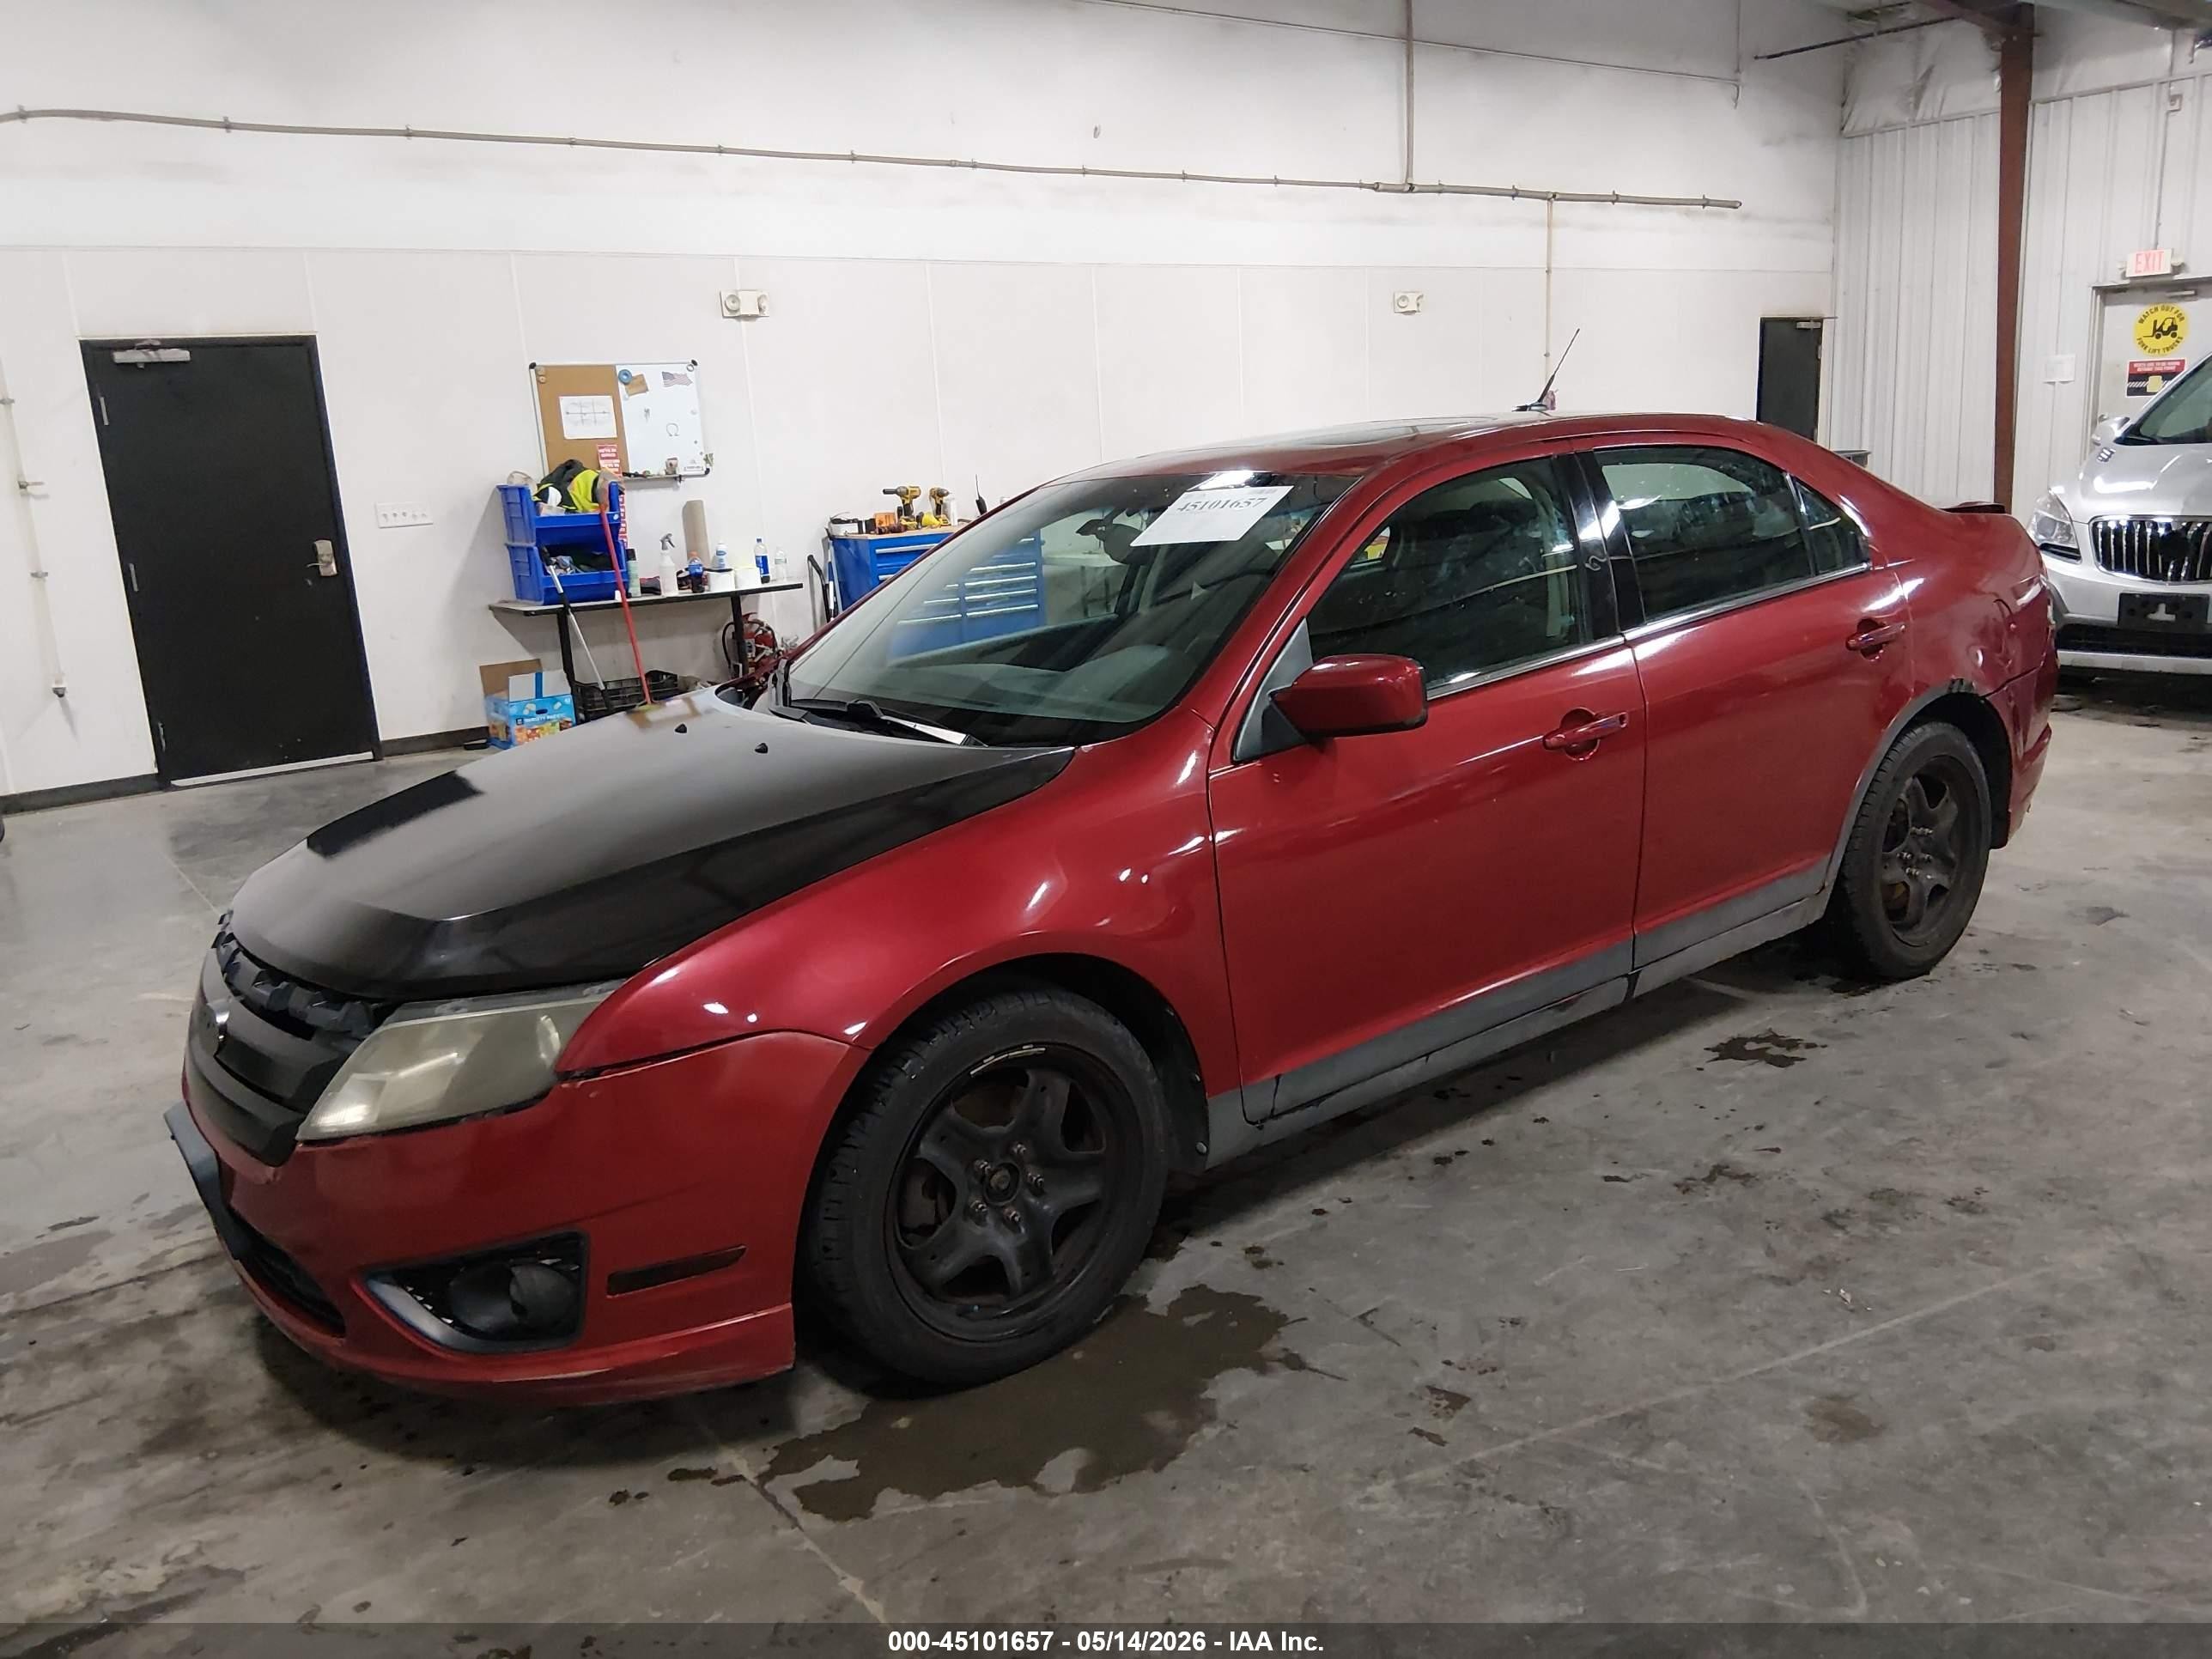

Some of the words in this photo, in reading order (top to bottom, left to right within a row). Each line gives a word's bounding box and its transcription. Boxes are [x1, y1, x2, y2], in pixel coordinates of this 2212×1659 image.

[2136, 252, 2164, 273] EXIT
[2138, 307, 2159, 324] WATCH
[2173, 309, 2185, 322] FOR
[2136, 337, 2148, 350] FORK
[1177, 497, 1268, 512] 45101657
